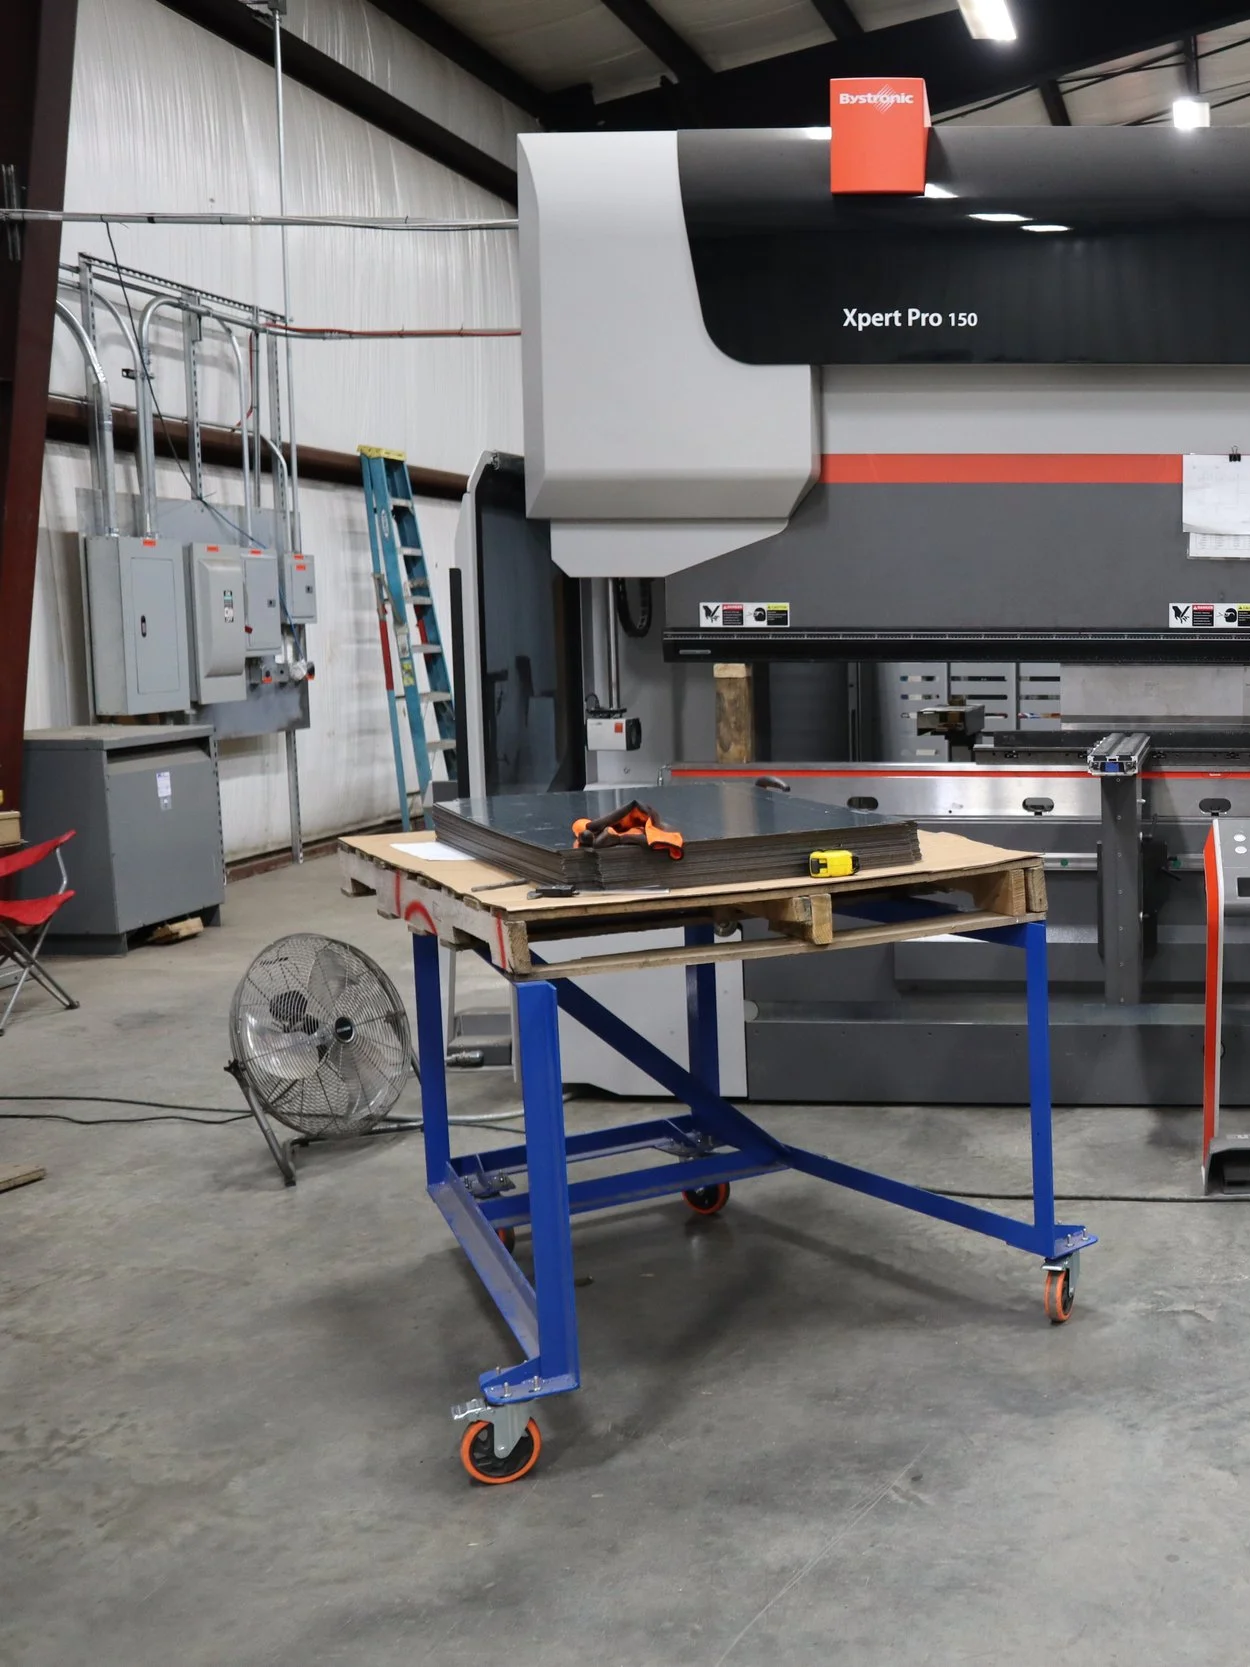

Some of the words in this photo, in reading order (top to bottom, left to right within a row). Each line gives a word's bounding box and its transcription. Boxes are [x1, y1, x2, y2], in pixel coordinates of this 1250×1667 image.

[839, 92, 914, 104] Bystronic
[842, 308, 902, 331] Xpert
[907, 308, 943, 327] Pro
[948, 312, 978, 327] 150
